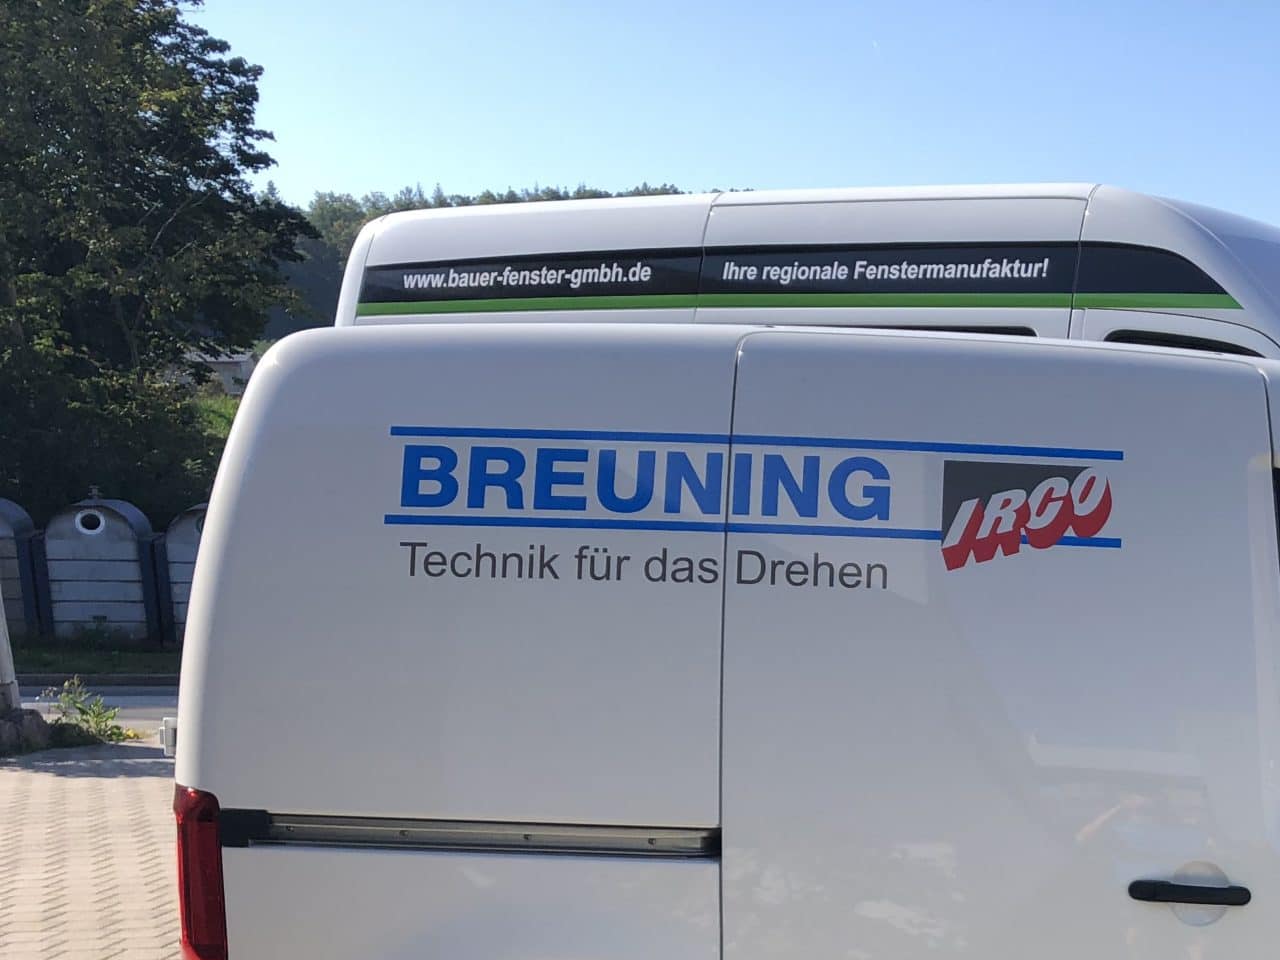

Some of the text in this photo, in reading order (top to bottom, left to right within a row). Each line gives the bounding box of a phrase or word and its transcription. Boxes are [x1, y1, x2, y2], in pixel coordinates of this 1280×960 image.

[403, 262, 652, 289] www.bauer-fenster-gmbh.de
[722, 258, 1049, 285] Ihre regionale Fenstermanufaktur!
[400, 444, 892, 522] BREUNING
[941, 467, 1112, 571] IRCO
[399, 541, 889, 590] Technik für das Drehen
